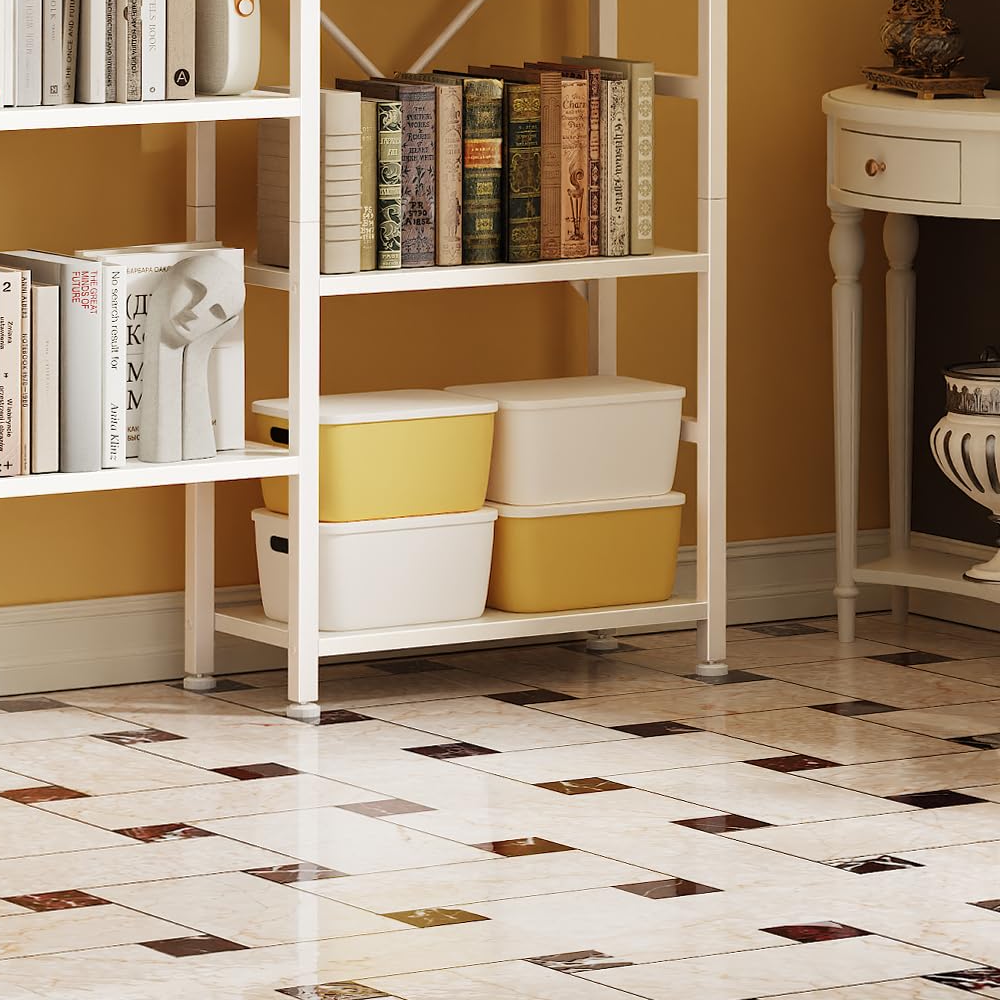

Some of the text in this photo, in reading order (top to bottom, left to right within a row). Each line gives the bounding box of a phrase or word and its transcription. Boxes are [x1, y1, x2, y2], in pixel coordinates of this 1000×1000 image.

[67, 20, 75, 37] AND
[148, 24, 157, 52] BOOK
[66, 39, 74, 63] ONCE
[64, 67, 72, 79] THE
[2, 281, 12, 293] 2
[72, 271, 81, 303] FUTURE
[81, 271, 90, 309] MINDS OF
[90, 271, 98, 315] THE GREAT
[6, 321, 14, 344] Zmiana
[111, 271, 120, 370] No search result for
[5, 406, 13, 437] labiryncie
[110, 403, 120, 461] Anita Klinz
